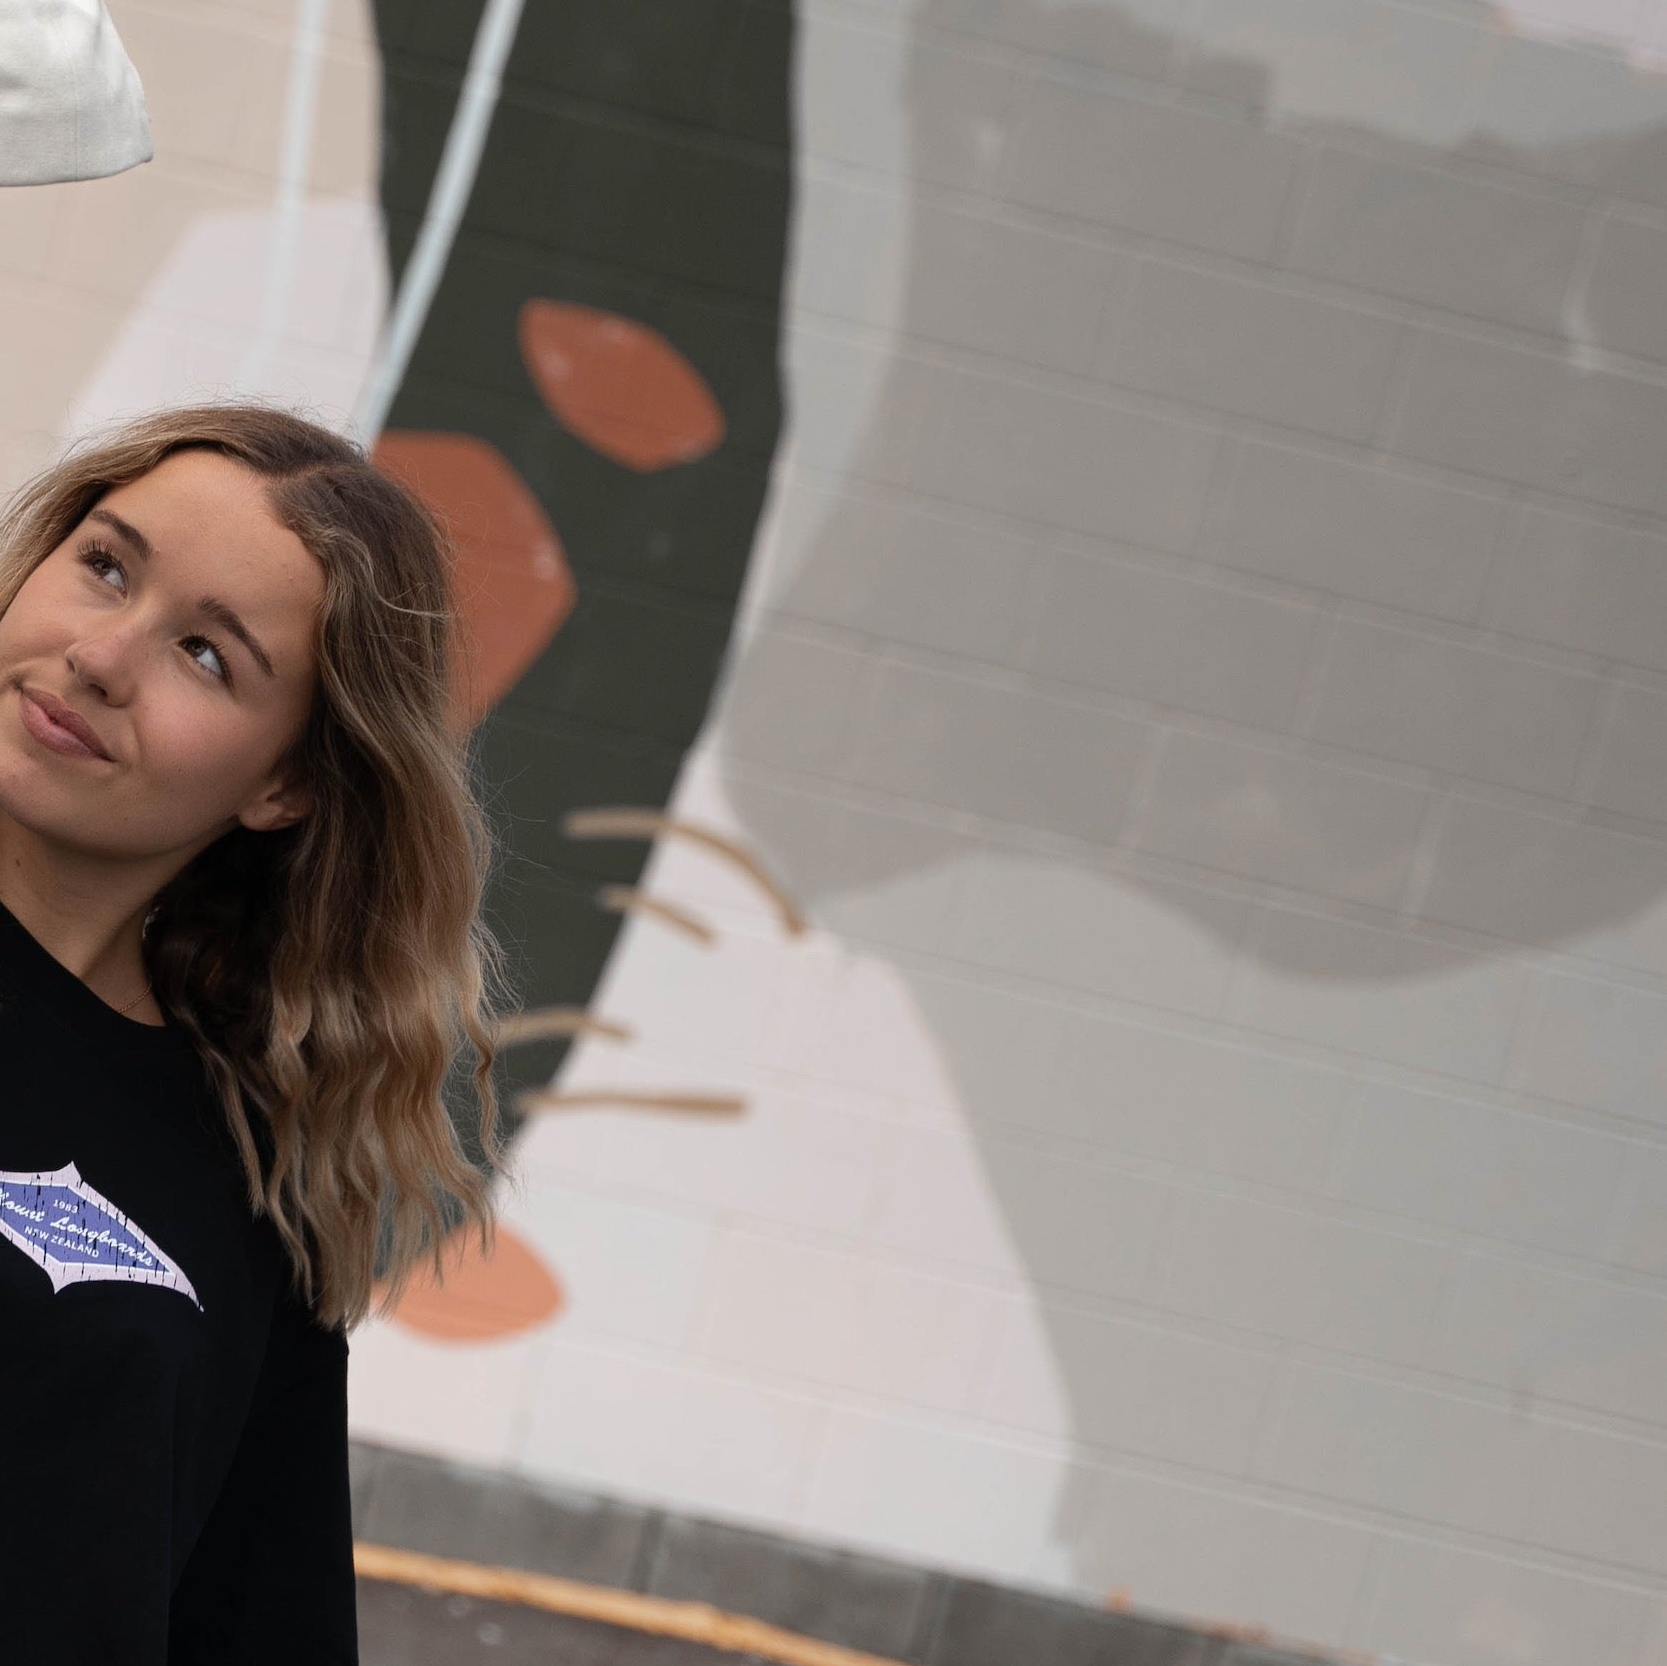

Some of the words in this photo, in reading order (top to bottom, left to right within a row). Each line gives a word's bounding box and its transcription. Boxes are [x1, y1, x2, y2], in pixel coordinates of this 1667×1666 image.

[53, 1199, 79, 1214] 1983
[49, 1216, 154, 1267] Longboards
[50, 1235, 100, 1258] ZEALAND
